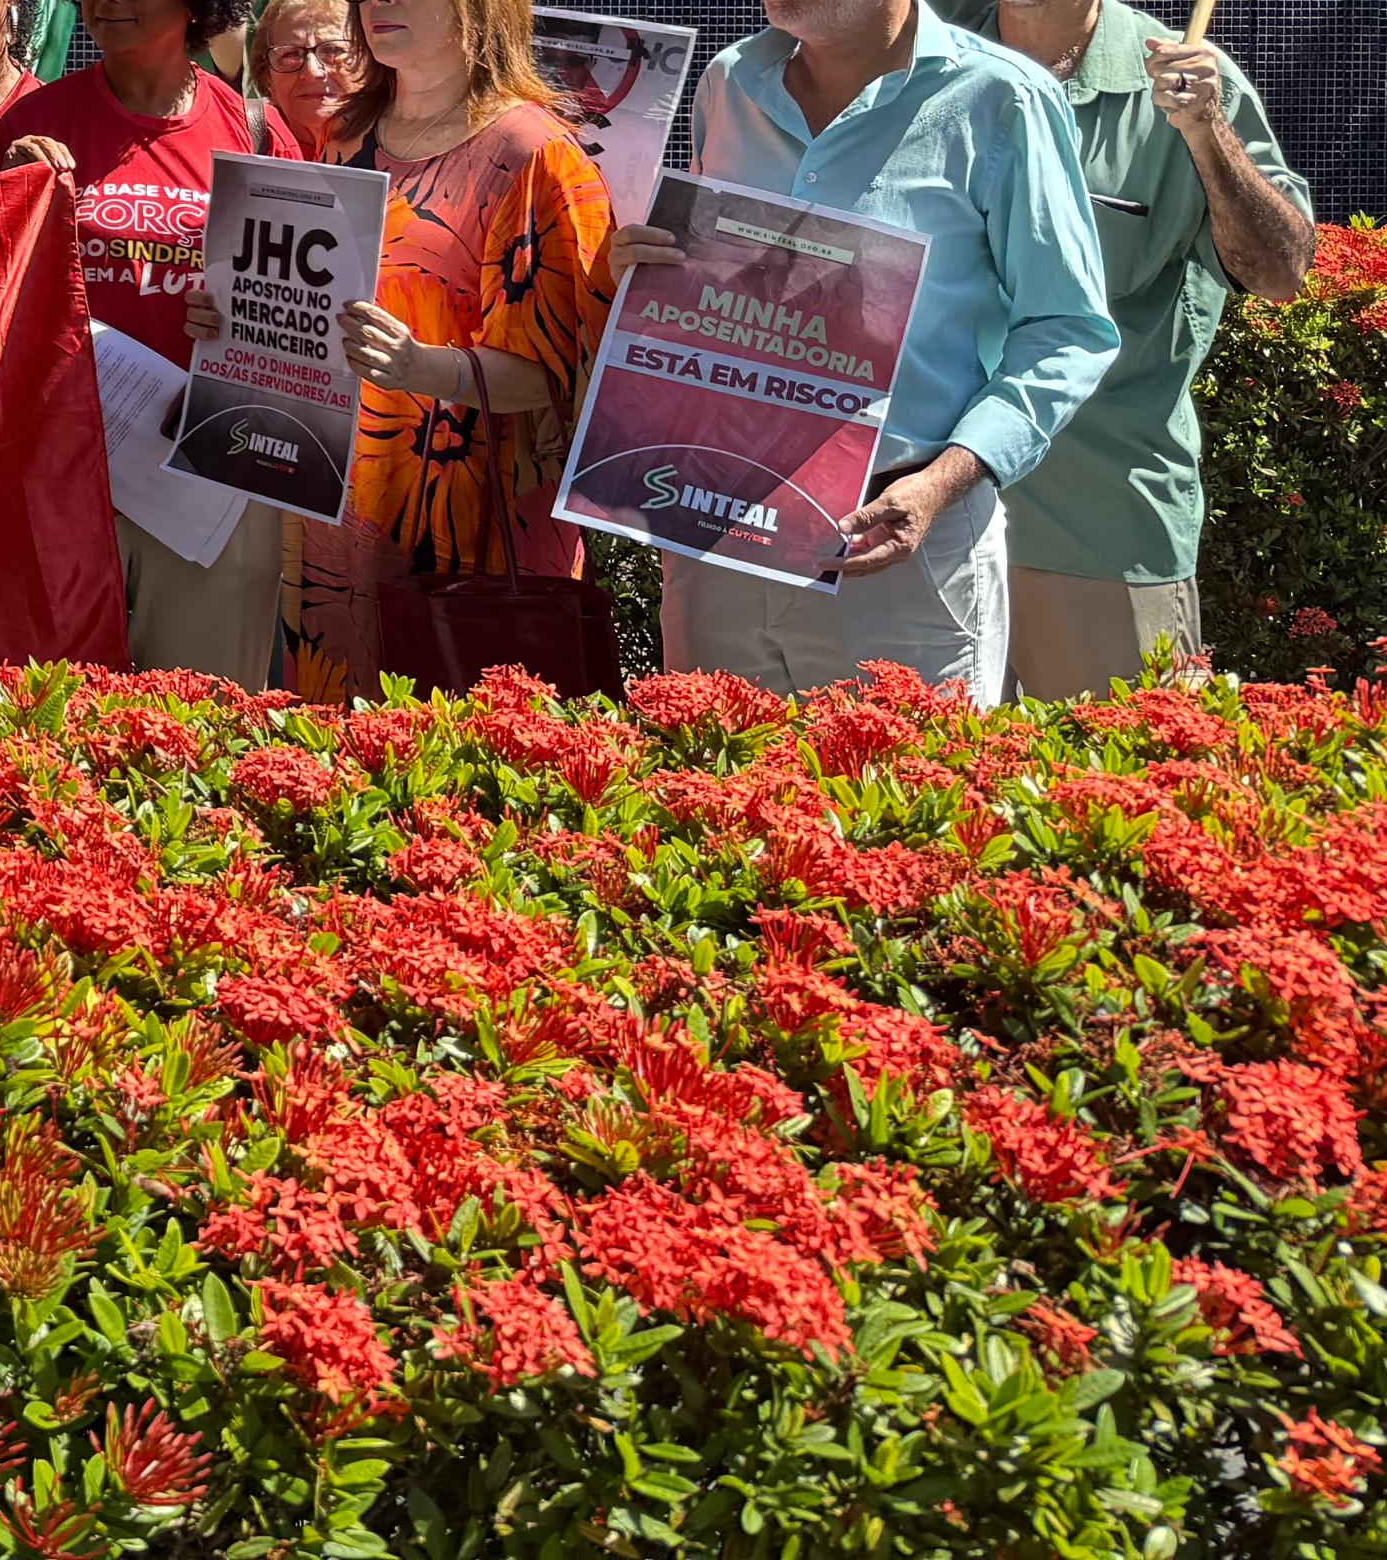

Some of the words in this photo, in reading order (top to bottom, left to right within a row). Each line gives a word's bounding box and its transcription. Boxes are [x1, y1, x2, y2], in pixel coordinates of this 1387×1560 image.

[103, 184, 160, 197] BASE
[164, 187, 210, 203] VEM
[75, 199, 205, 247] FORÇ
[109, 239, 203, 268] SINDPR
[232, 217, 339, 288] JHC
[140, 262, 205, 296] LUT
[232, 276, 304, 308] APOSTOU
[307, 292, 331, 312] NO
[231, 297, 330, 337] MERCADO
[697, 282, 831, 346] MINHA
[231, 321, 329, 361] FINANCEIRO
[638, 299, 875, 384] APOSENTADORIA
[200, 358, 248, 383] DOS/AS
[249, 371, 352, 409] SERVIDORES/AS!
[224, 347, 254, 367] COM
[256, 355, 268, 370] O
[270, 358, 331, 387] DINHEIRO
[625, 346, 701, 383] ESTÁ
[709, 364, 758, 395] EM
[763, 374, 872, 419] RISCO!
[227, 418, 299, 463] SINTEAL
[639, 464, 778, 532] SINTEAL
